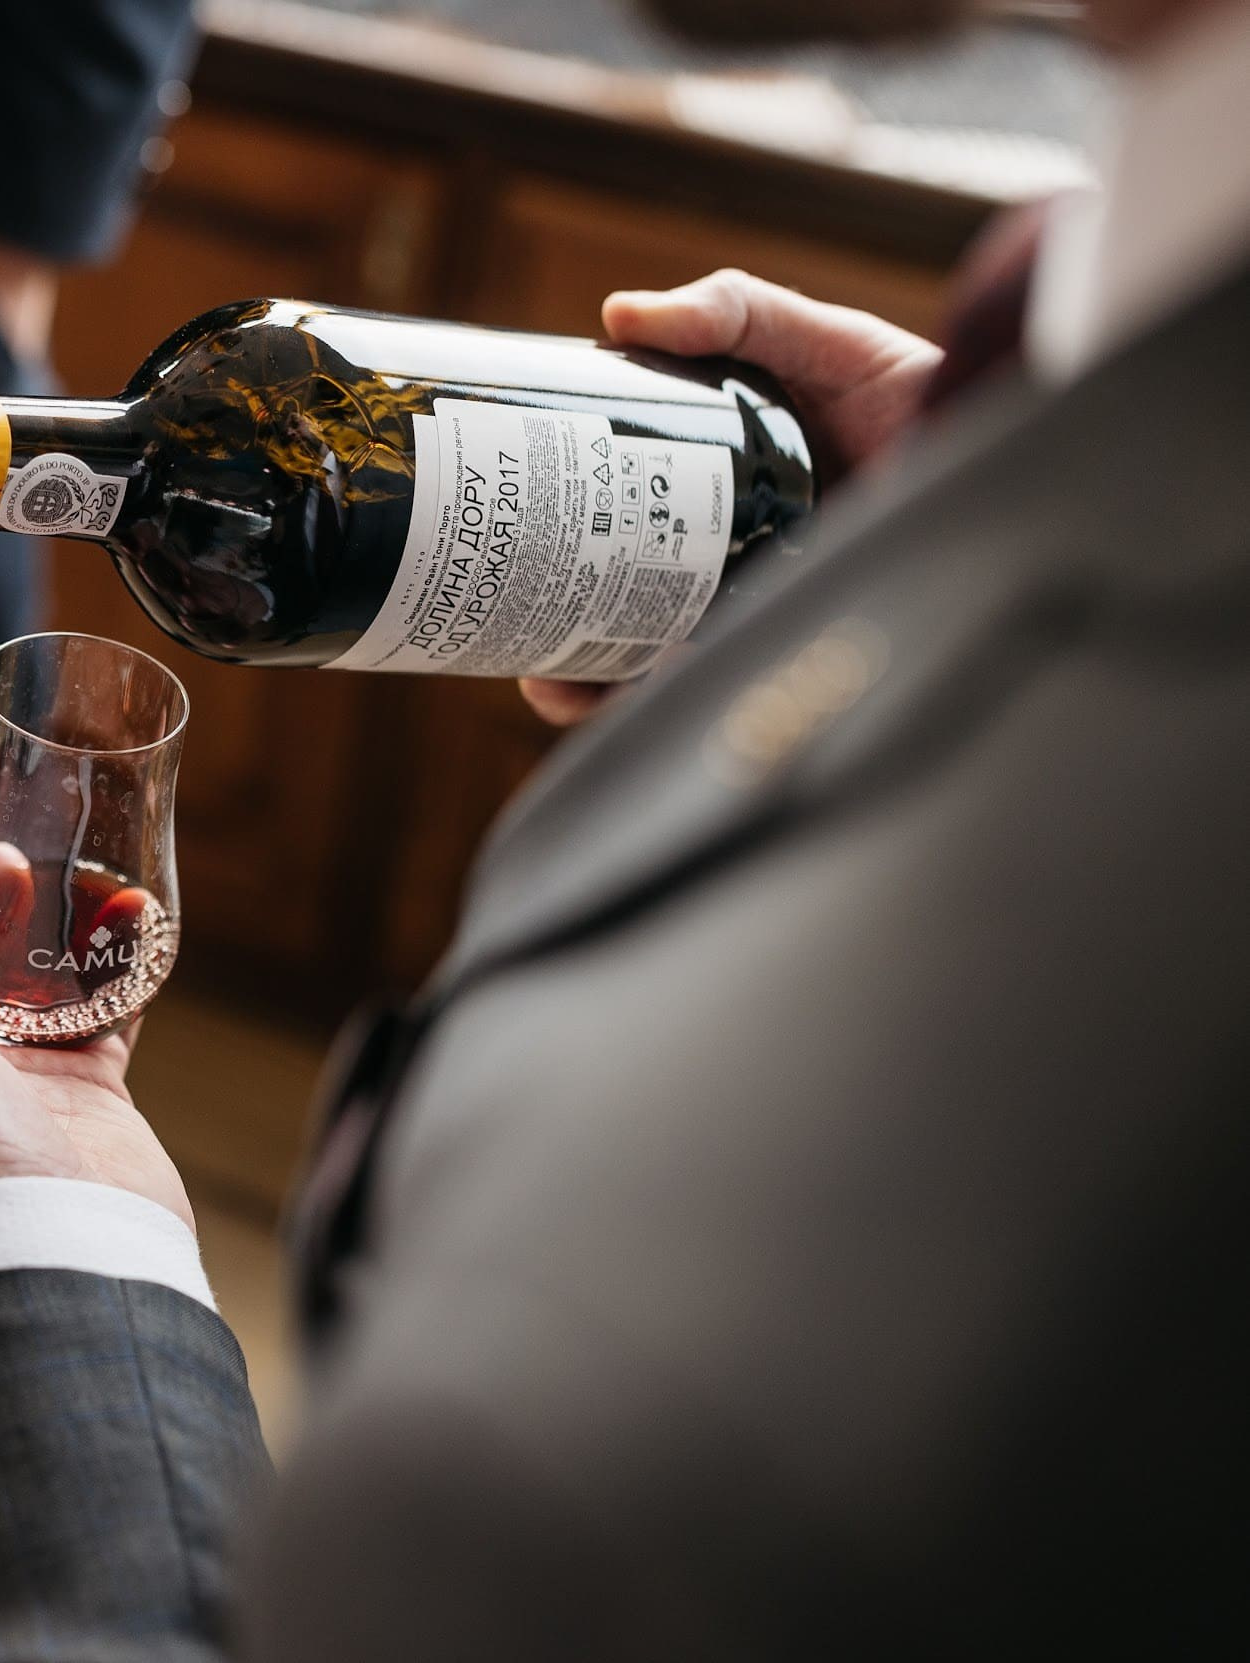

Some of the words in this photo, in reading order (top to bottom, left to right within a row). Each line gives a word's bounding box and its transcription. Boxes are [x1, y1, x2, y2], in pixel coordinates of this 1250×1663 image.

[17, 467, 39, 492] DOURO
[38, 463, 46, 472] E
[45, 461, 58, 469] DO
[453, 450, 462, 513] происхождения
[438, 504, 451, 534] Порто
[449, 515, 459, 539] места
[516, 506, 524, 527] года
[408, 558, 474, 649] ДОЛИНА
[456, 465, 486, 551] ДОРУ
[427, 632, 477, 658] ГОД
[457, 520, 515, 626] УРОЖАЯ
[497, 450, 518, 512] 2017
[432, 535, 445, 561] Тони
[423, 560, 439, 585] Файн
[465, 559, 484, 595] DOC/DO
[27, 939, 141, 973] CAMU
